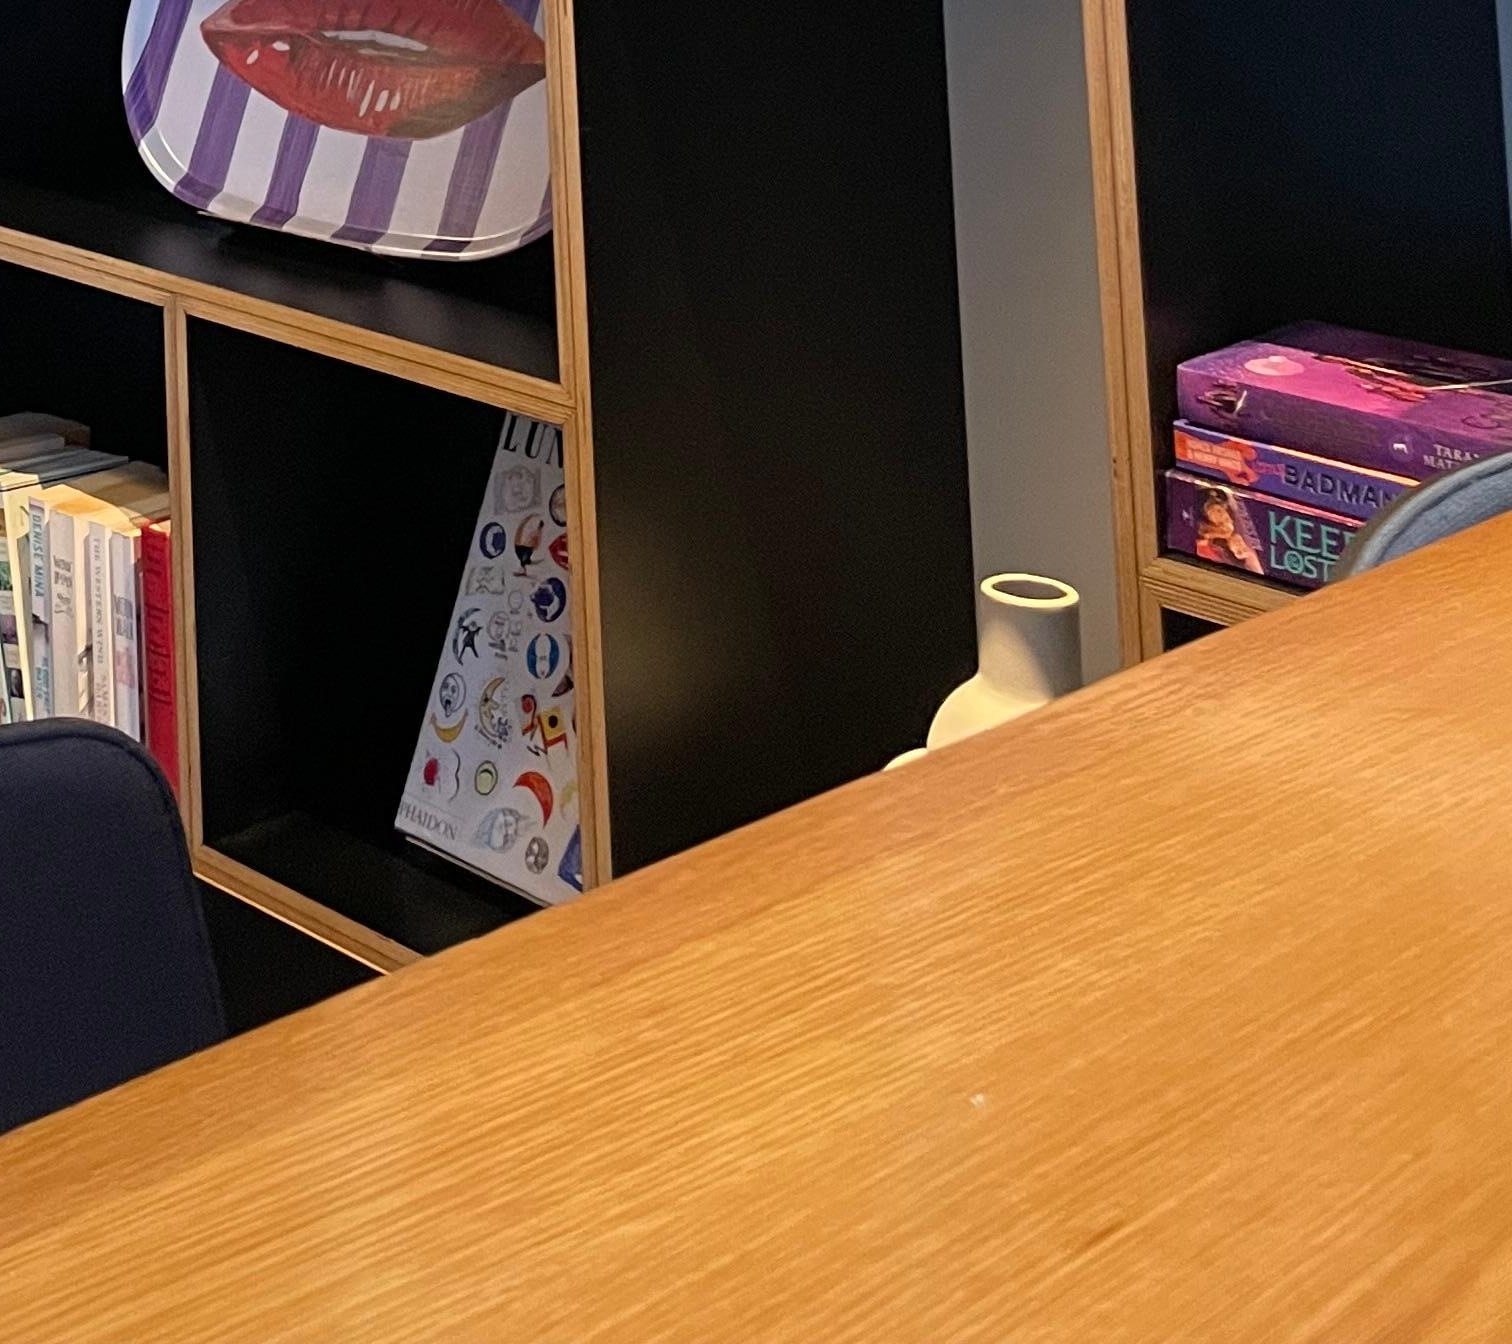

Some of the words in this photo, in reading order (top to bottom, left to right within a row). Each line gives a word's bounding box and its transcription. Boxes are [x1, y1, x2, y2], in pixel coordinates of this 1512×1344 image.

[1432, 442, 1480, 461] TARA
[31, 514, 44, 562] DENISE
[34, 565, 46, 597] MINA
[399, 800, 458, 841] PHAIDON
